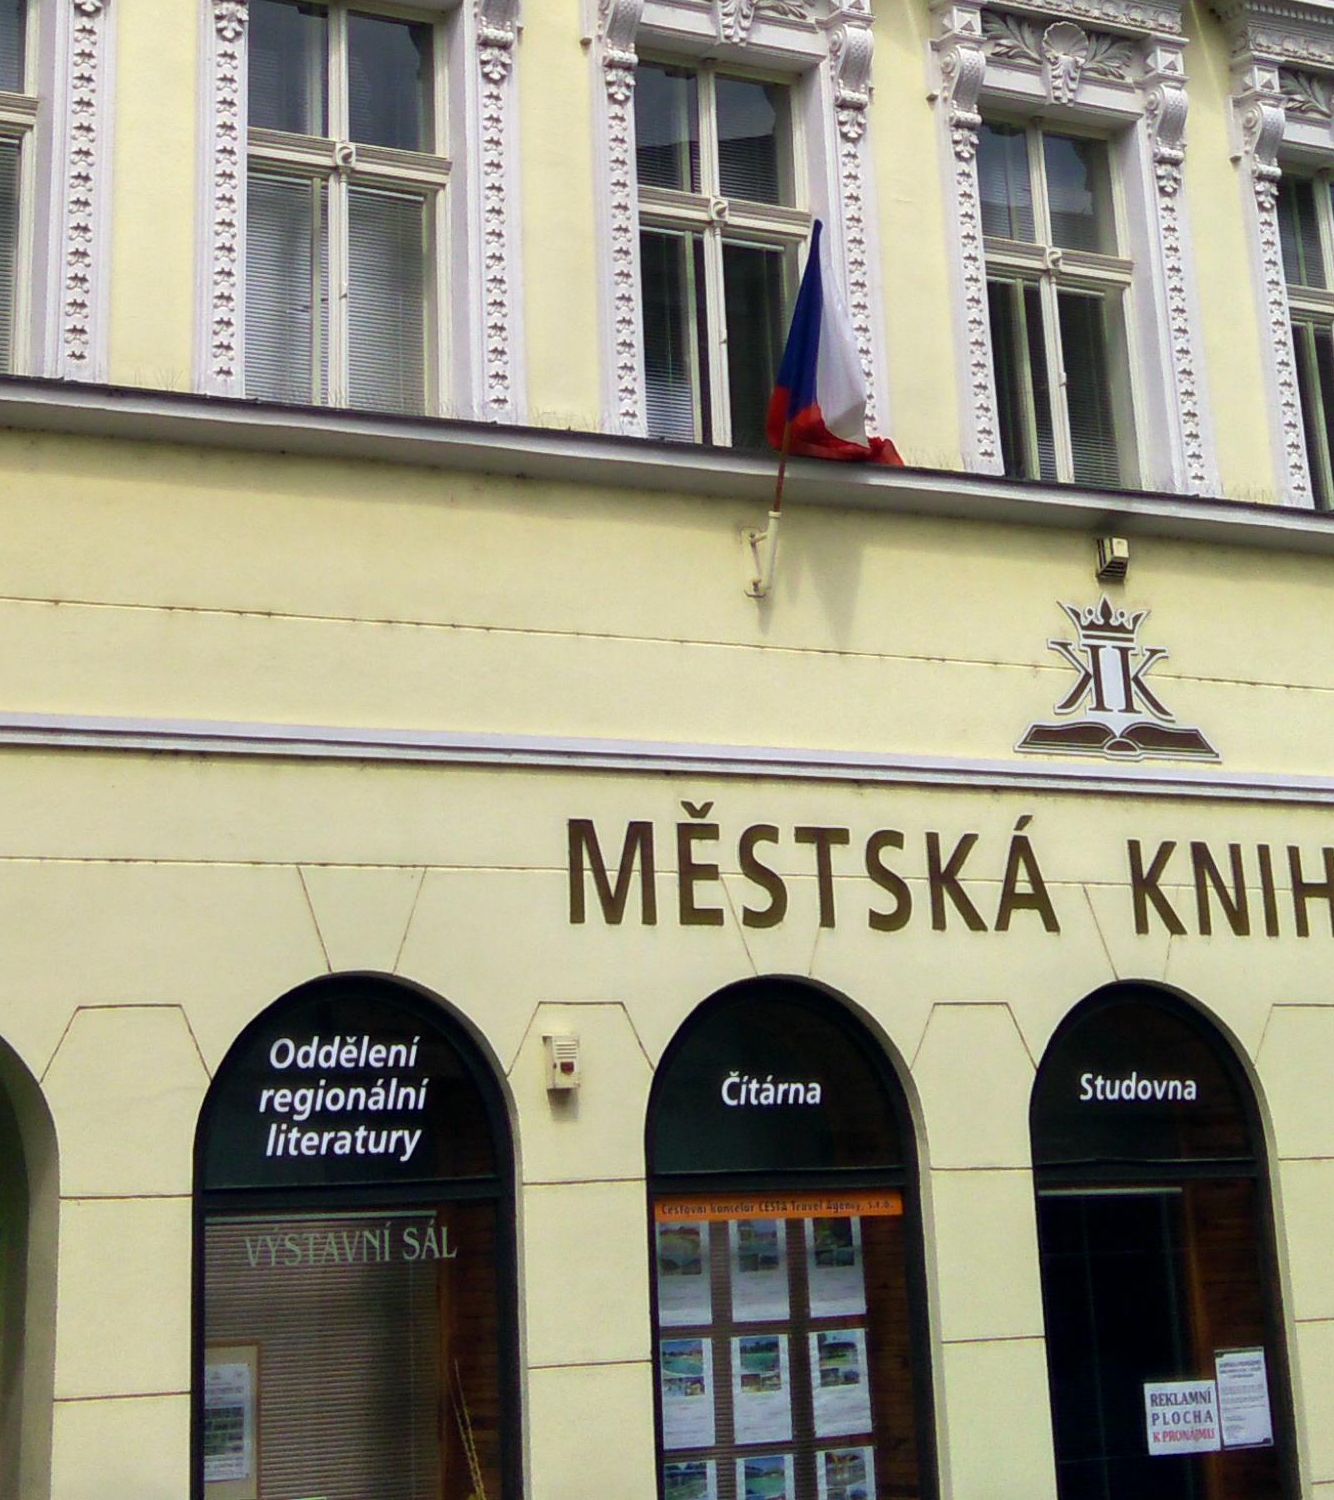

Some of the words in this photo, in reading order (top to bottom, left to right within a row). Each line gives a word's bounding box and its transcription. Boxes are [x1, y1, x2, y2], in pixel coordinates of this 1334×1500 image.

[567, 801, 1061, 934] MĚSTSKÁ
[269, 1035, 420, 1069] Oddělení
[258, 1077, 429, 1121] regionální
[721, 1071, 821, 1106] Čítárna
[1079, 1072, 1197, 1101] Studovna
[266, 1123, 422, 1162] literatury
[758, 1200, 788, 1212] CESTA
[791, 1200, 823, 1212] Travel
[244, 1221, 392, 1268] VÝSTAVNÍ
[402, 1218, 458, 1261] SÁL
[1150, 1387, 1212, 1407] REKLAMNÍ
[1151, 1409, 1213, 1426] PLOCHA
